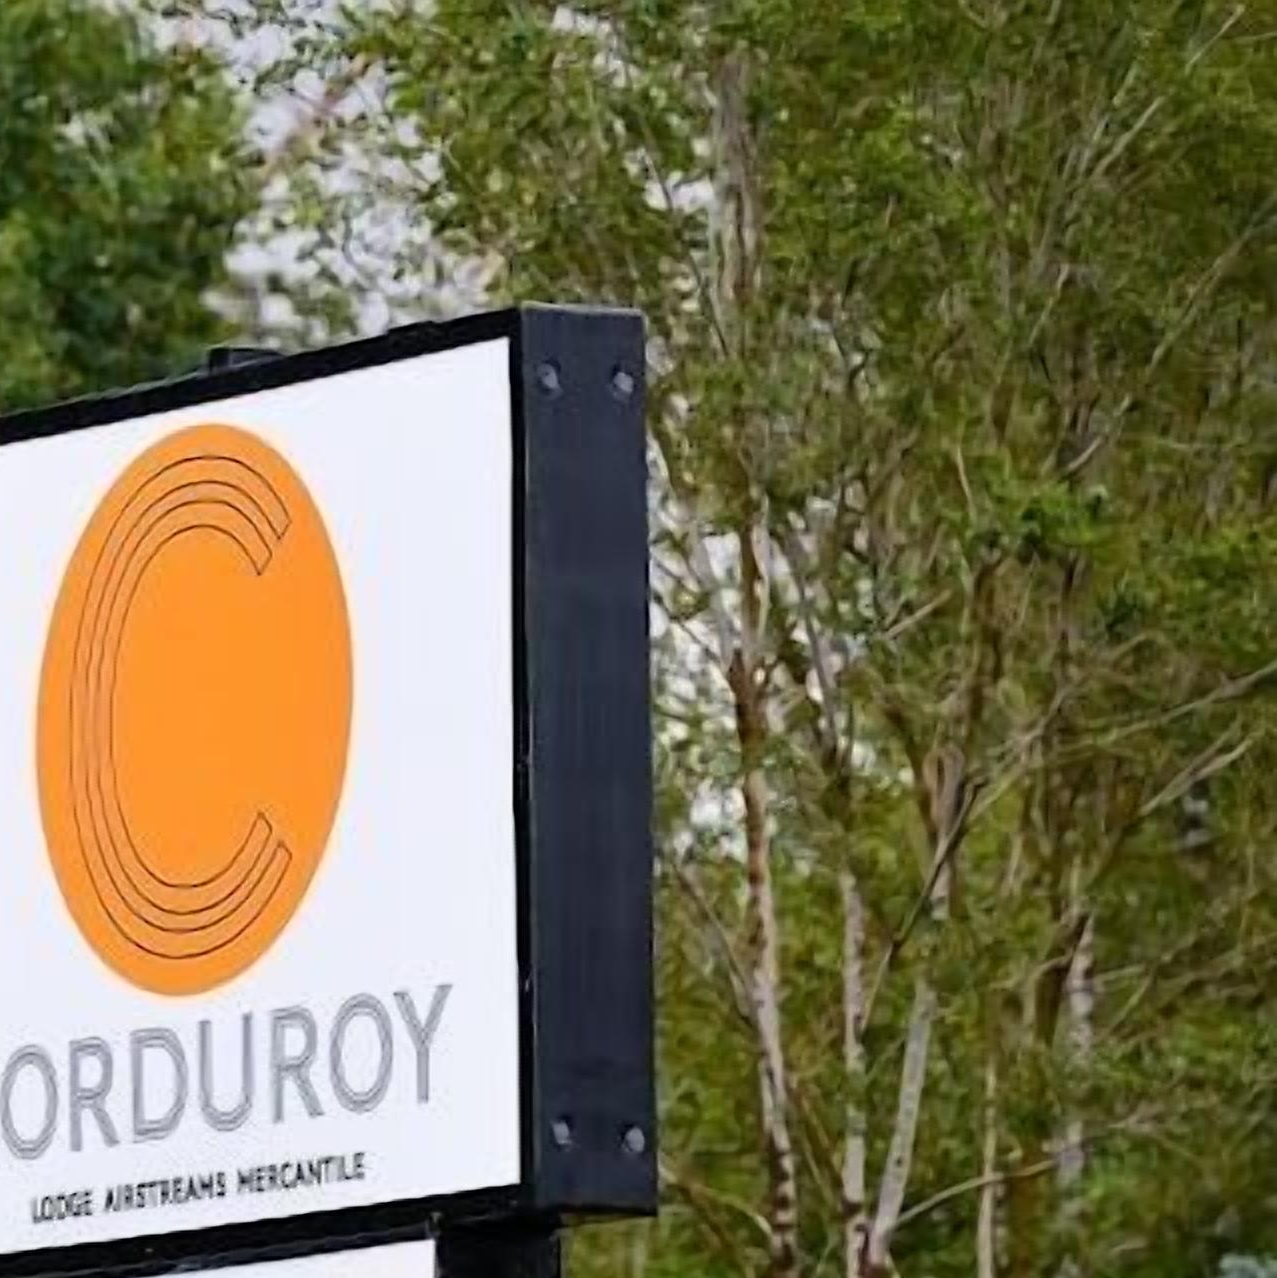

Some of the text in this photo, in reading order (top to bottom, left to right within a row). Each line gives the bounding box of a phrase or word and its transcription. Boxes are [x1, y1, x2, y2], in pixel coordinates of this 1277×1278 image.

[69, 455, 293, 960] C
[31, 1151, 365, 1223] LODGE AIRSTREAMS MERCANTILE
